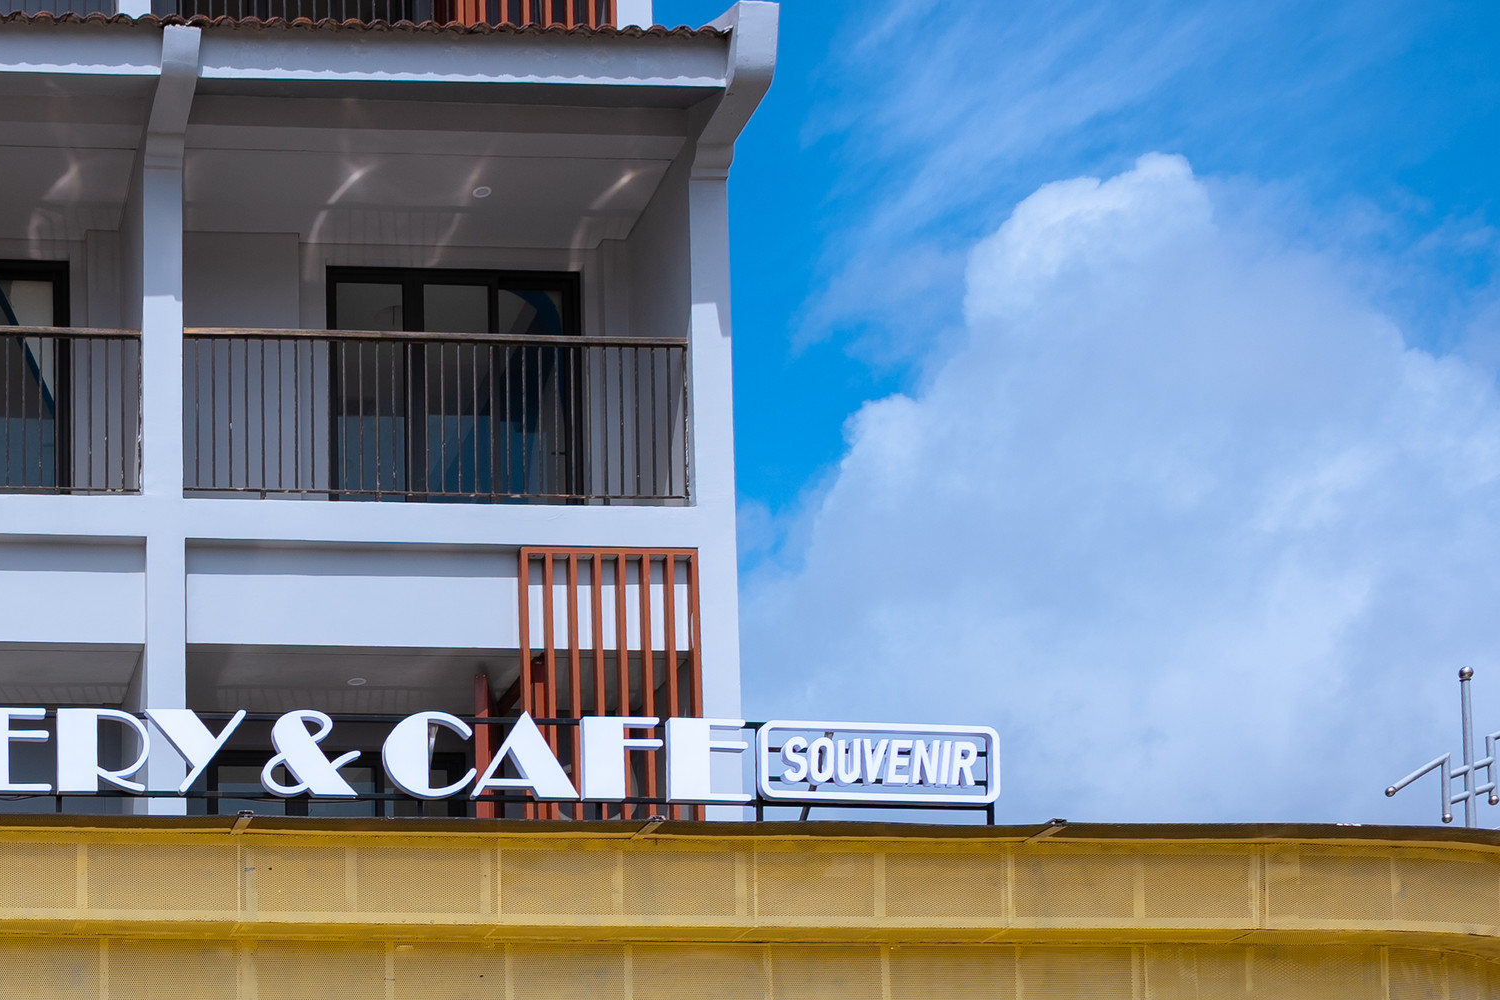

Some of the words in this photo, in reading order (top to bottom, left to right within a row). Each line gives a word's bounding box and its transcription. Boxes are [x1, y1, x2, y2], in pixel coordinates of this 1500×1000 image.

[261, 709, 361, 798] &
[383, 711, 752, 801] CAFE
[781, 737, 977, 787] SOUVENIR
